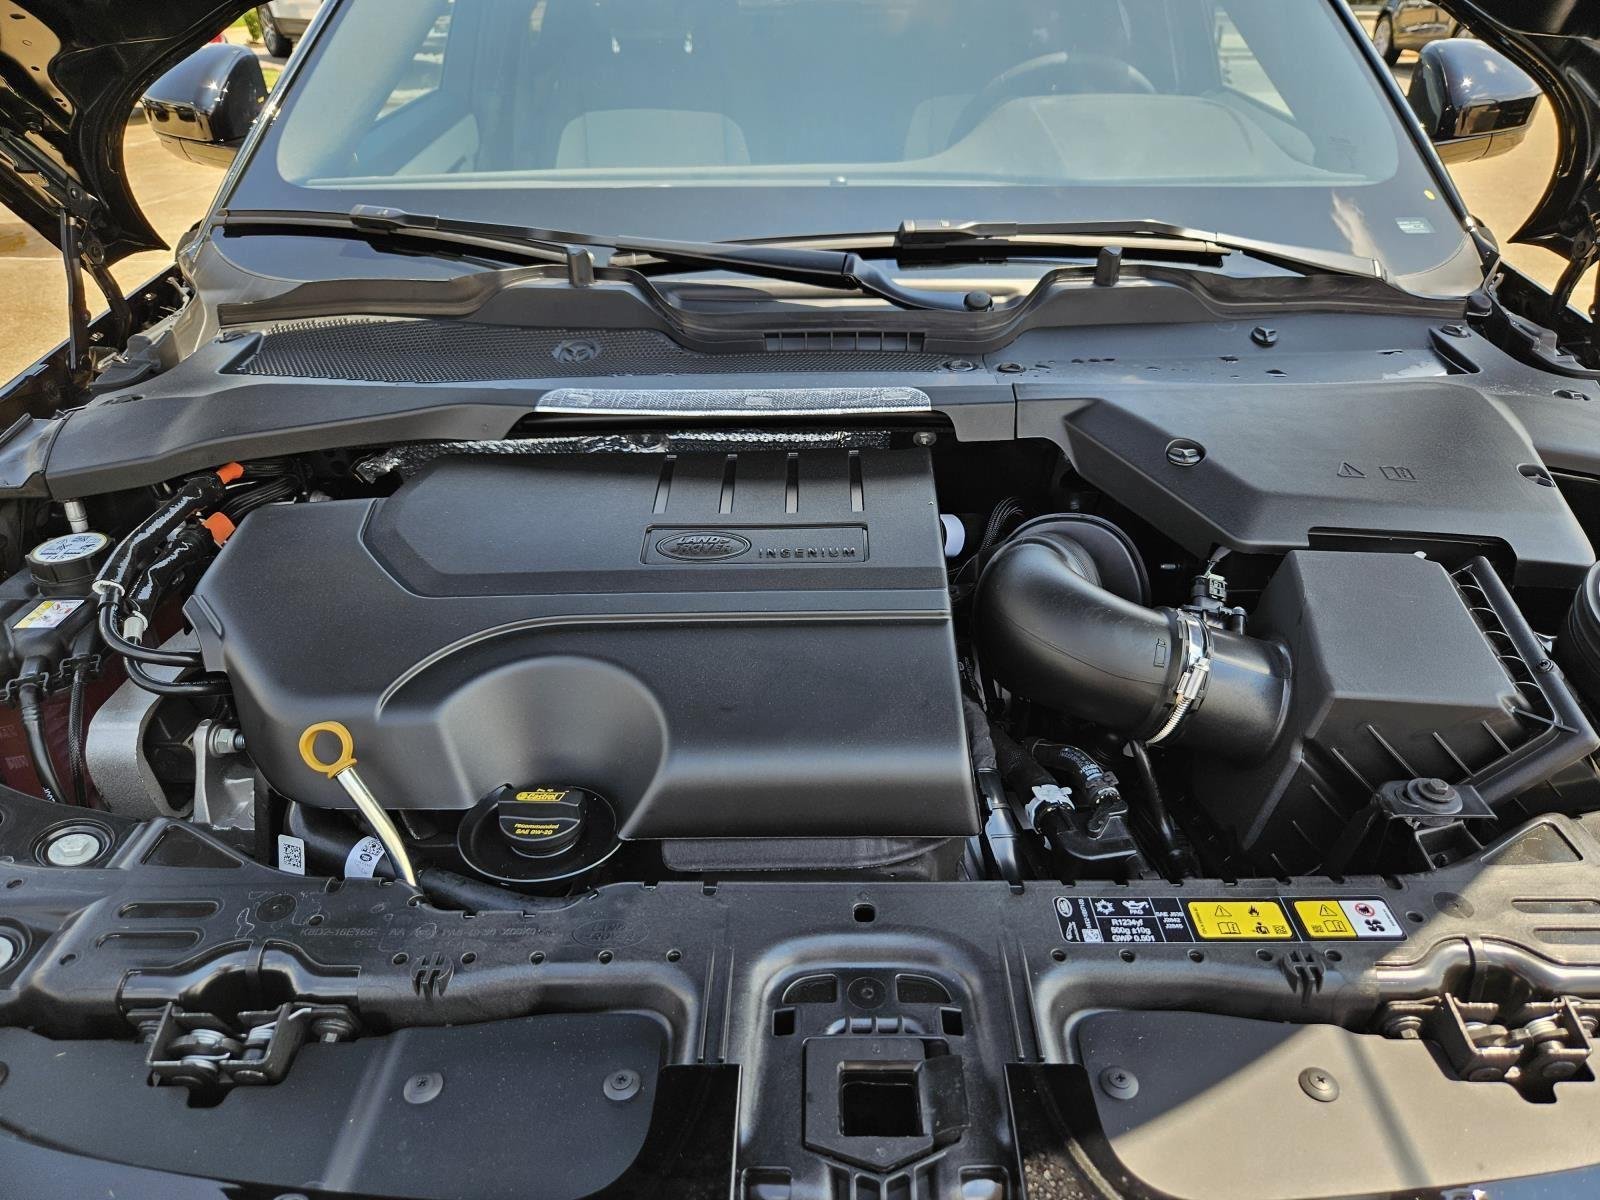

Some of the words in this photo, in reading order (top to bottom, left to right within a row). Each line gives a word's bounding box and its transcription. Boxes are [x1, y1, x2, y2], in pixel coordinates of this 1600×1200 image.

[677, 535, 721, 545] LAND
[758, 547, 856, 559] INGENIUM
[527, 792, 558, 800] Castrol
[1111, 918, 1144, 927] R1234yf
[1110, 926, 1131, 935] 500g
[1111, 934, 1133, 942] GWP
[1133, 934, 1156, 942] 0.501
